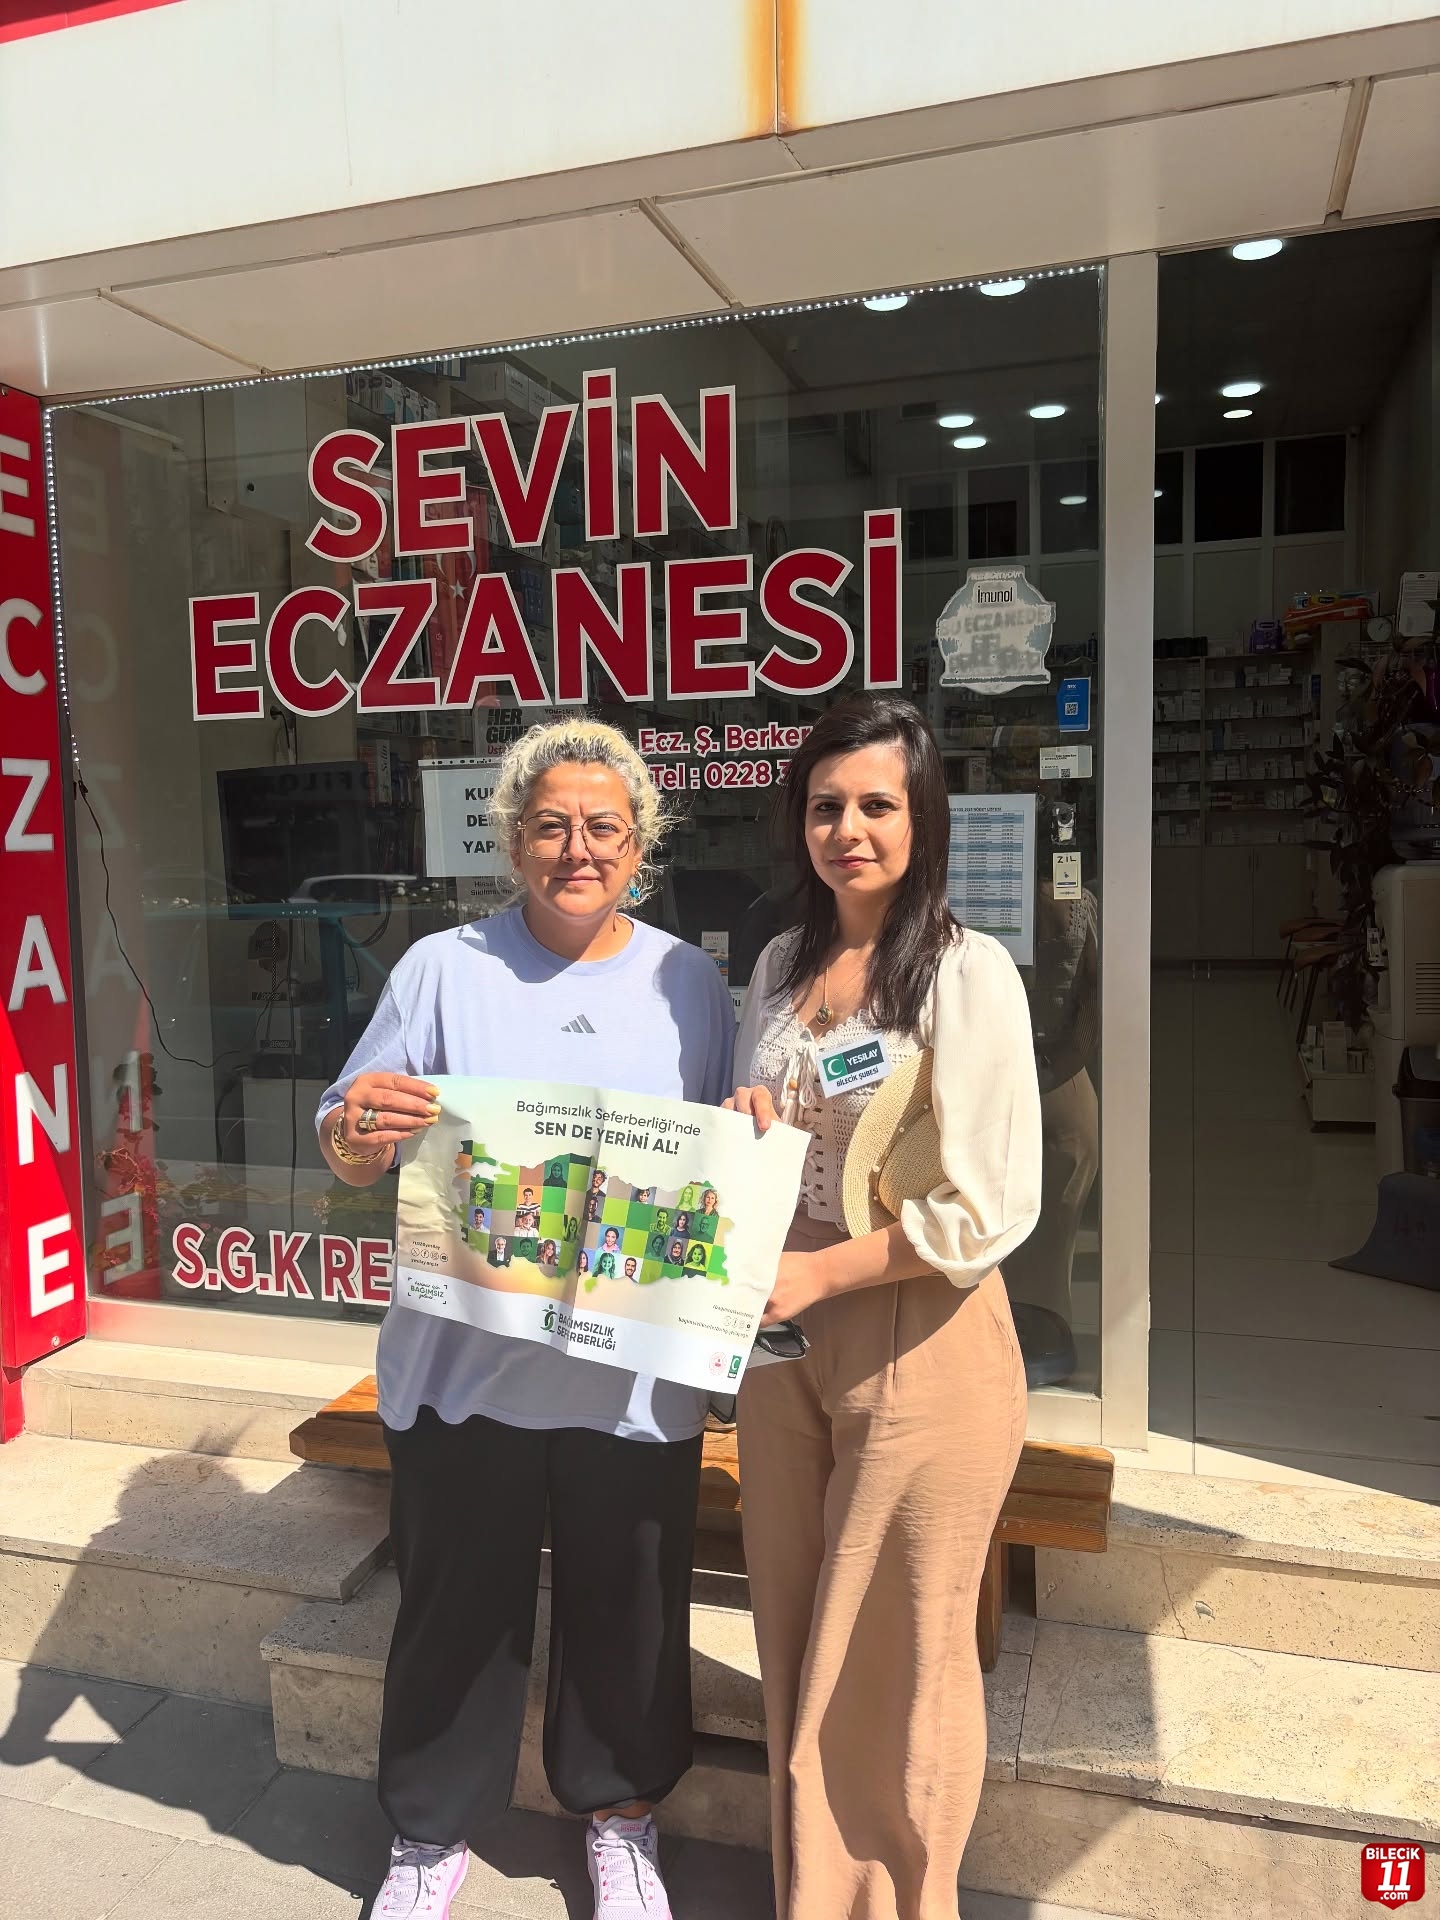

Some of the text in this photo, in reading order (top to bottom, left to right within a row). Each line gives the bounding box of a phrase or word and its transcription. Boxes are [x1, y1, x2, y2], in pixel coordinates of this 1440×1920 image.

[305, 368, 738, 562] SEVİN
[189, 507, 903, 721] ECZANESİ
[639, 728, 691, 754] Ecz.
[704, 760, 773, 789] 0228
[516, 1100, 592, 1118] Bağımsızlık
[534, 1121, 680, 1155] SEN DE YERİNİ AL!
[172, 1223, 314, 1300] S.G.K
